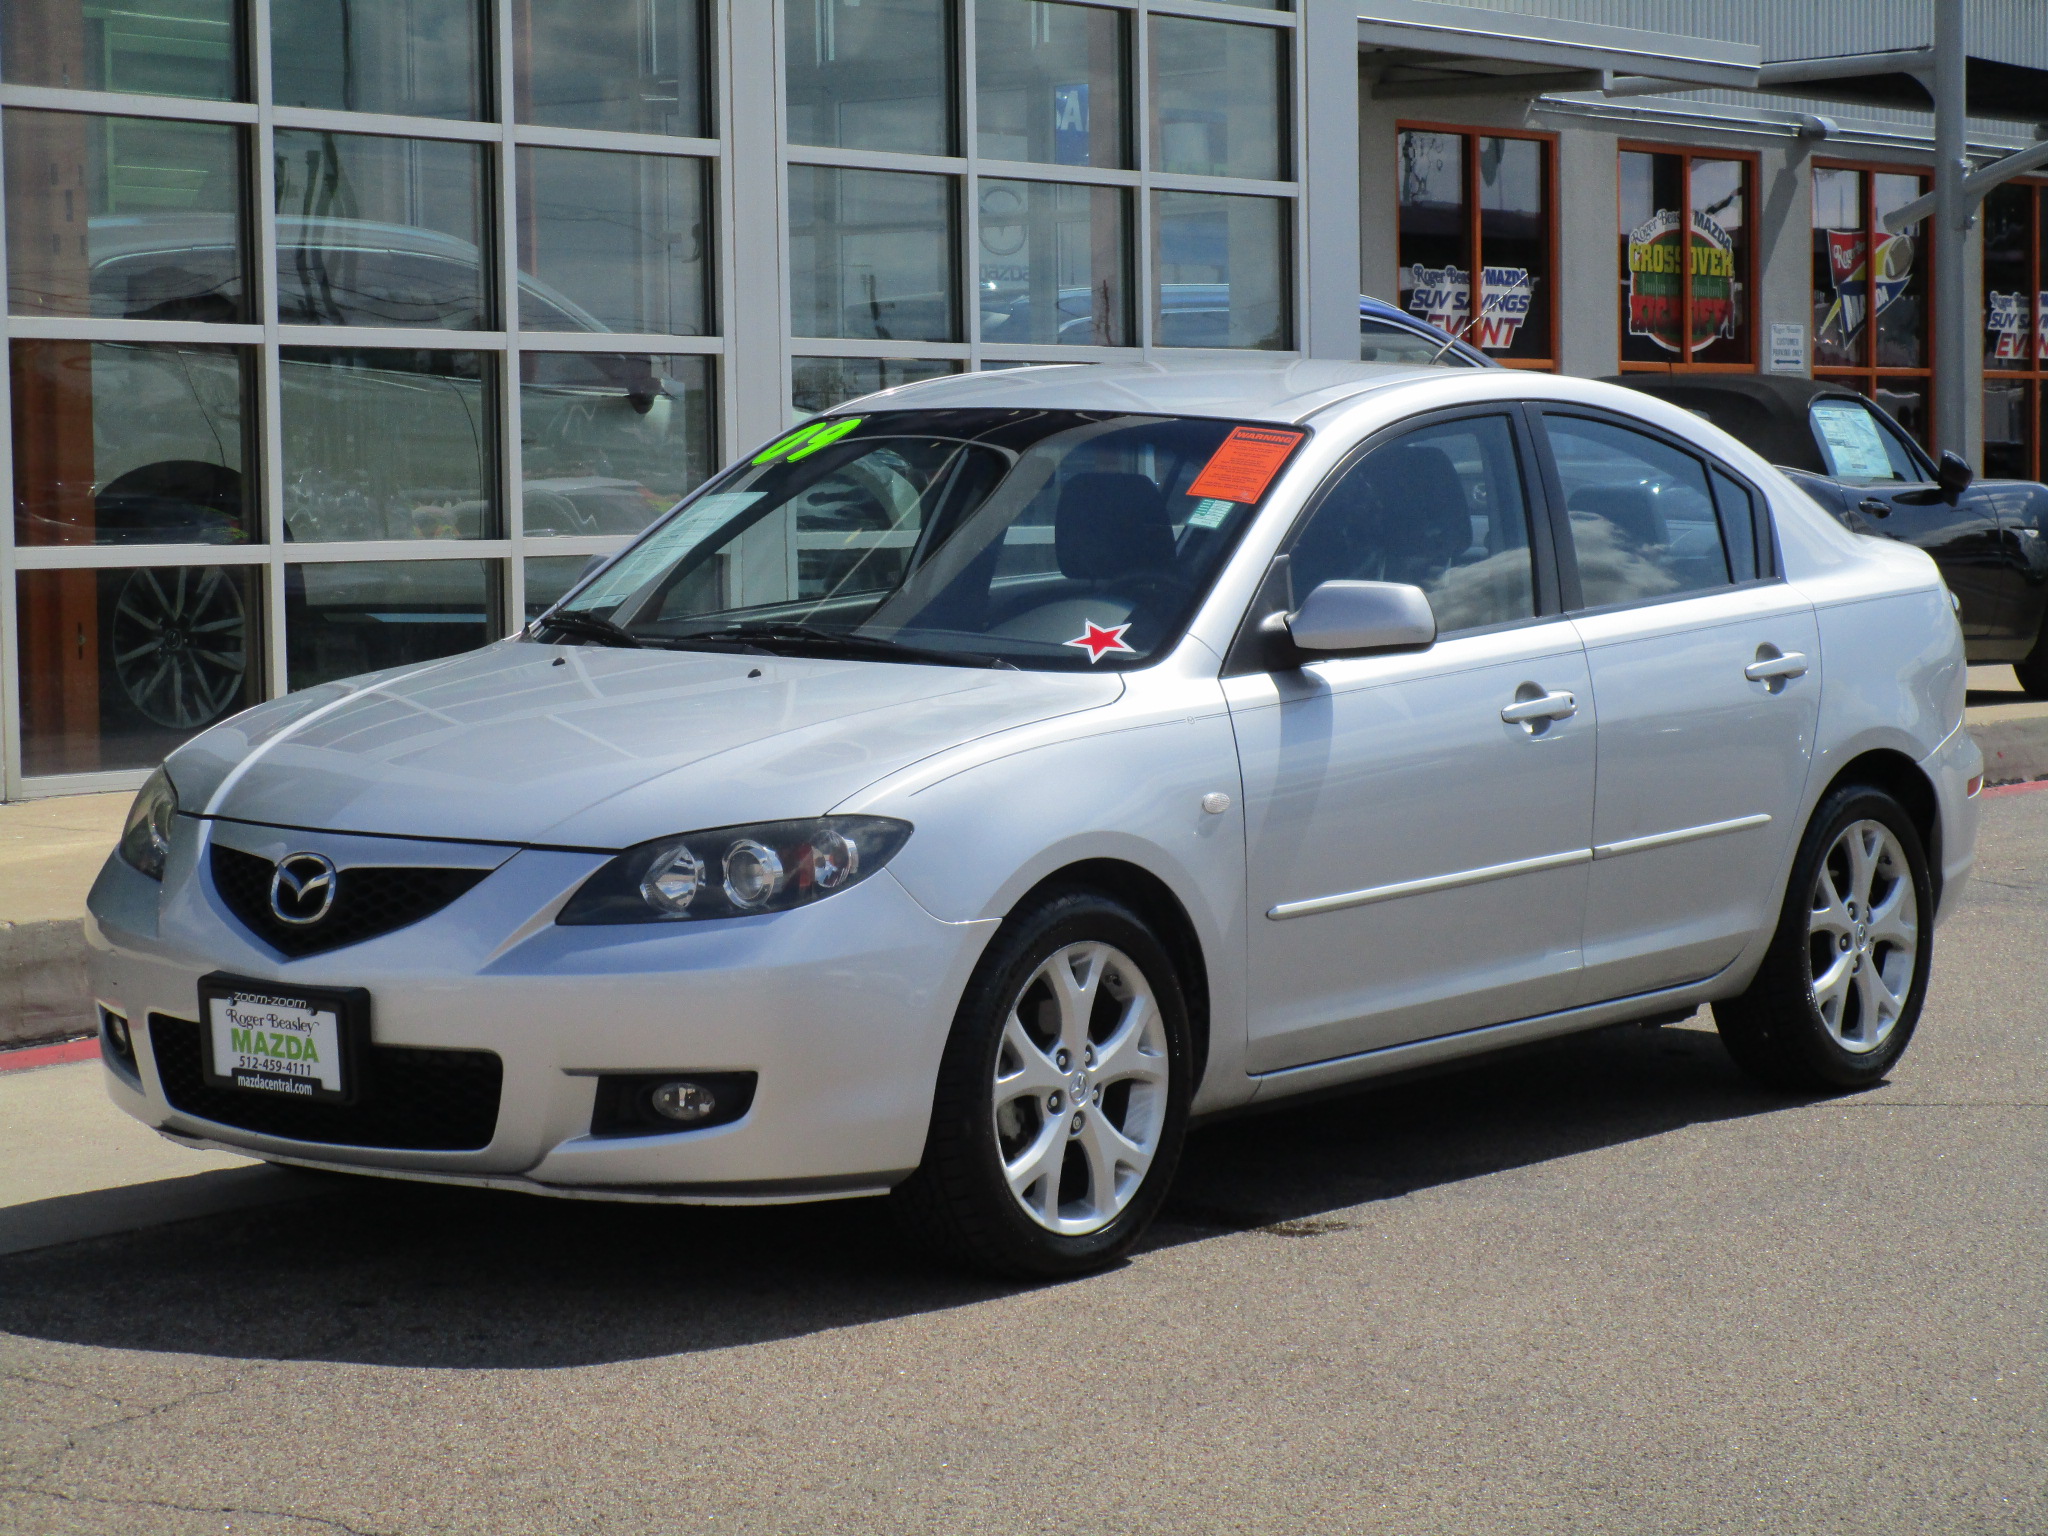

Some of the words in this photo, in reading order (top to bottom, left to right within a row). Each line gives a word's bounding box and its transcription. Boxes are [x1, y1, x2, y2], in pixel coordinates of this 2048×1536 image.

[1659, 210, 1681, 227] Beas
[1693, 211, 1732, 251] MAZDA
[1413, 265, 1445, 288] Roger
[1446, 267, 1475, 285] Beas
[1485, 268, 1530, 287] MAZDA
[1411, 289, 1451, 309] SUV
[1452, 291, 1530, 313] SVINGS
[1990, 313, 2017, 328] SUV
[752, 418, 862, 466] 09
[1236, 432, 1293, 444] WARNING
[234, 991, 307, 1009] zoom-zoom
[226, 1008, 265, 1030] Roger
[266, 1013, 320, 1037] Beasley
[231, 1028, 320, 1063] MAZDA
[239, 1055, 311, 1077] 512-459-4111
[237, 1074, 312, 1096] mazdacentral.com
